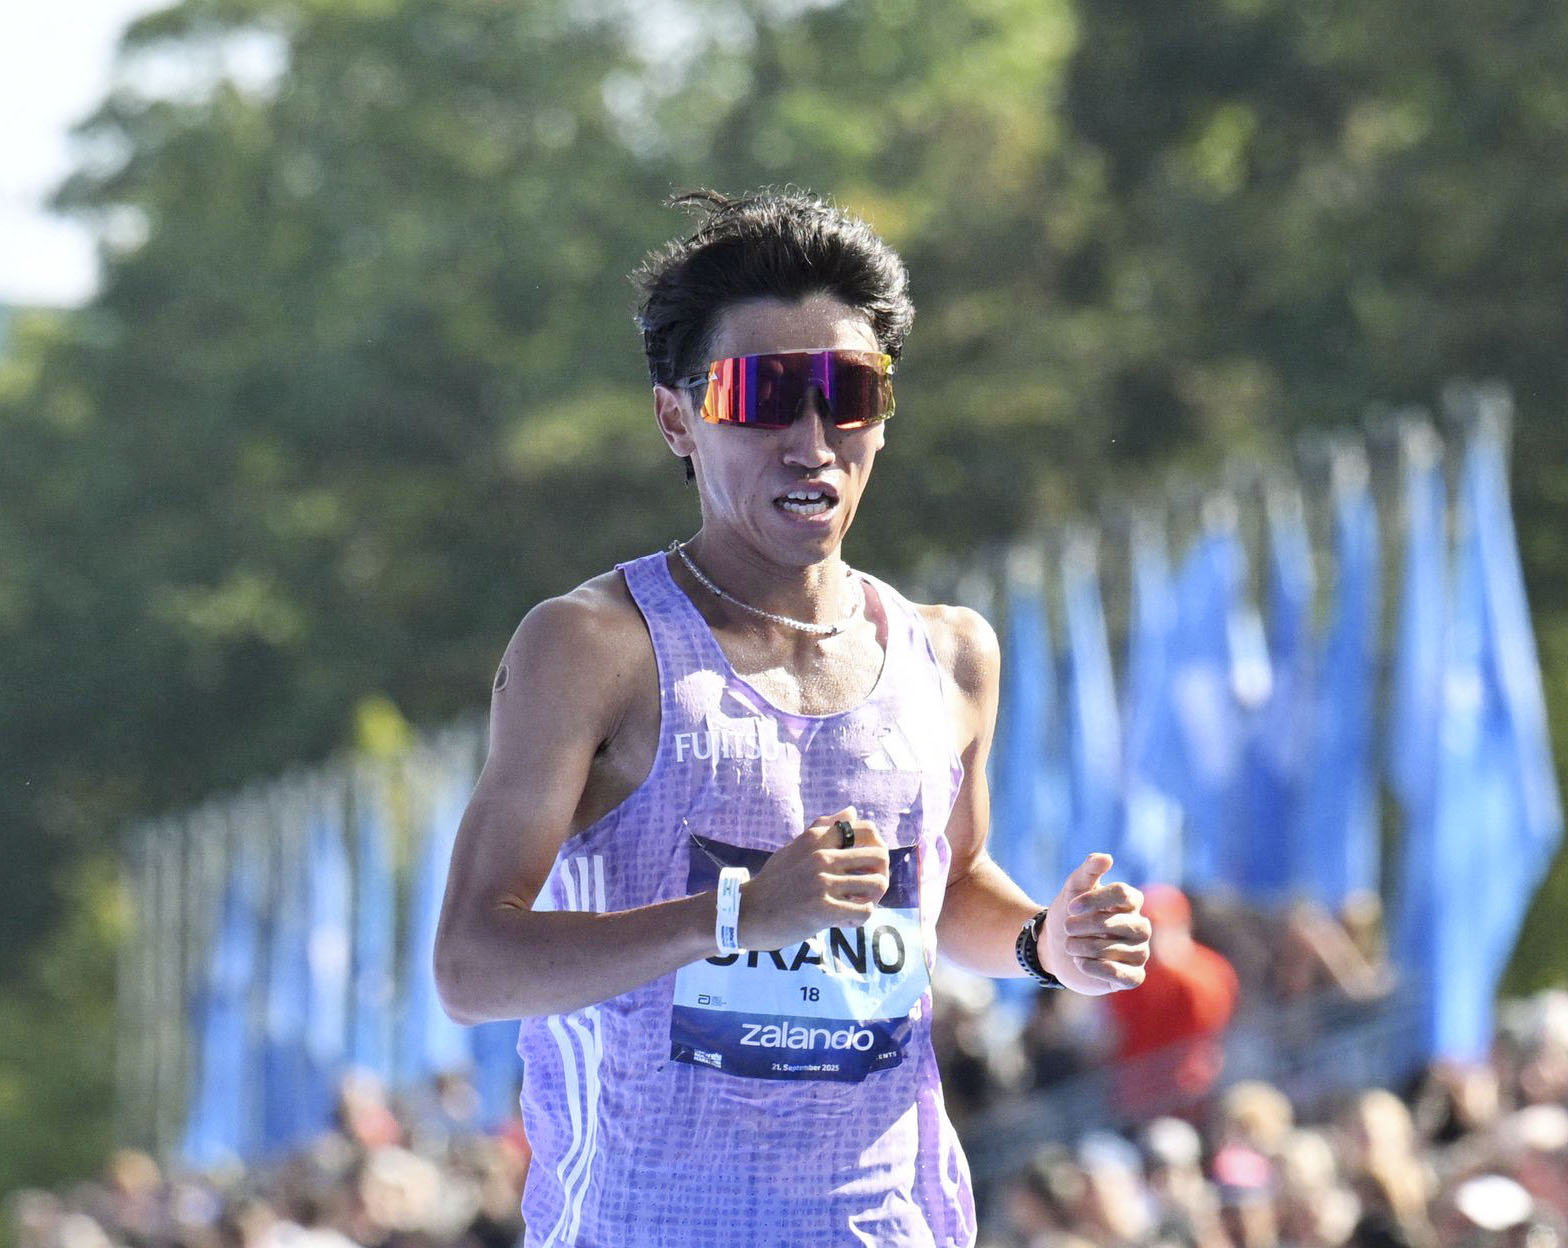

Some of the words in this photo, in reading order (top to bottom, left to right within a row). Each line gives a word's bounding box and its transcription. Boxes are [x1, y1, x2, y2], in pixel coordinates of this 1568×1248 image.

[801, 986, 820, 1002] 18
[740, 1021, 875, 1051] zalando
[822, 1064, 840, 1072] 2025
